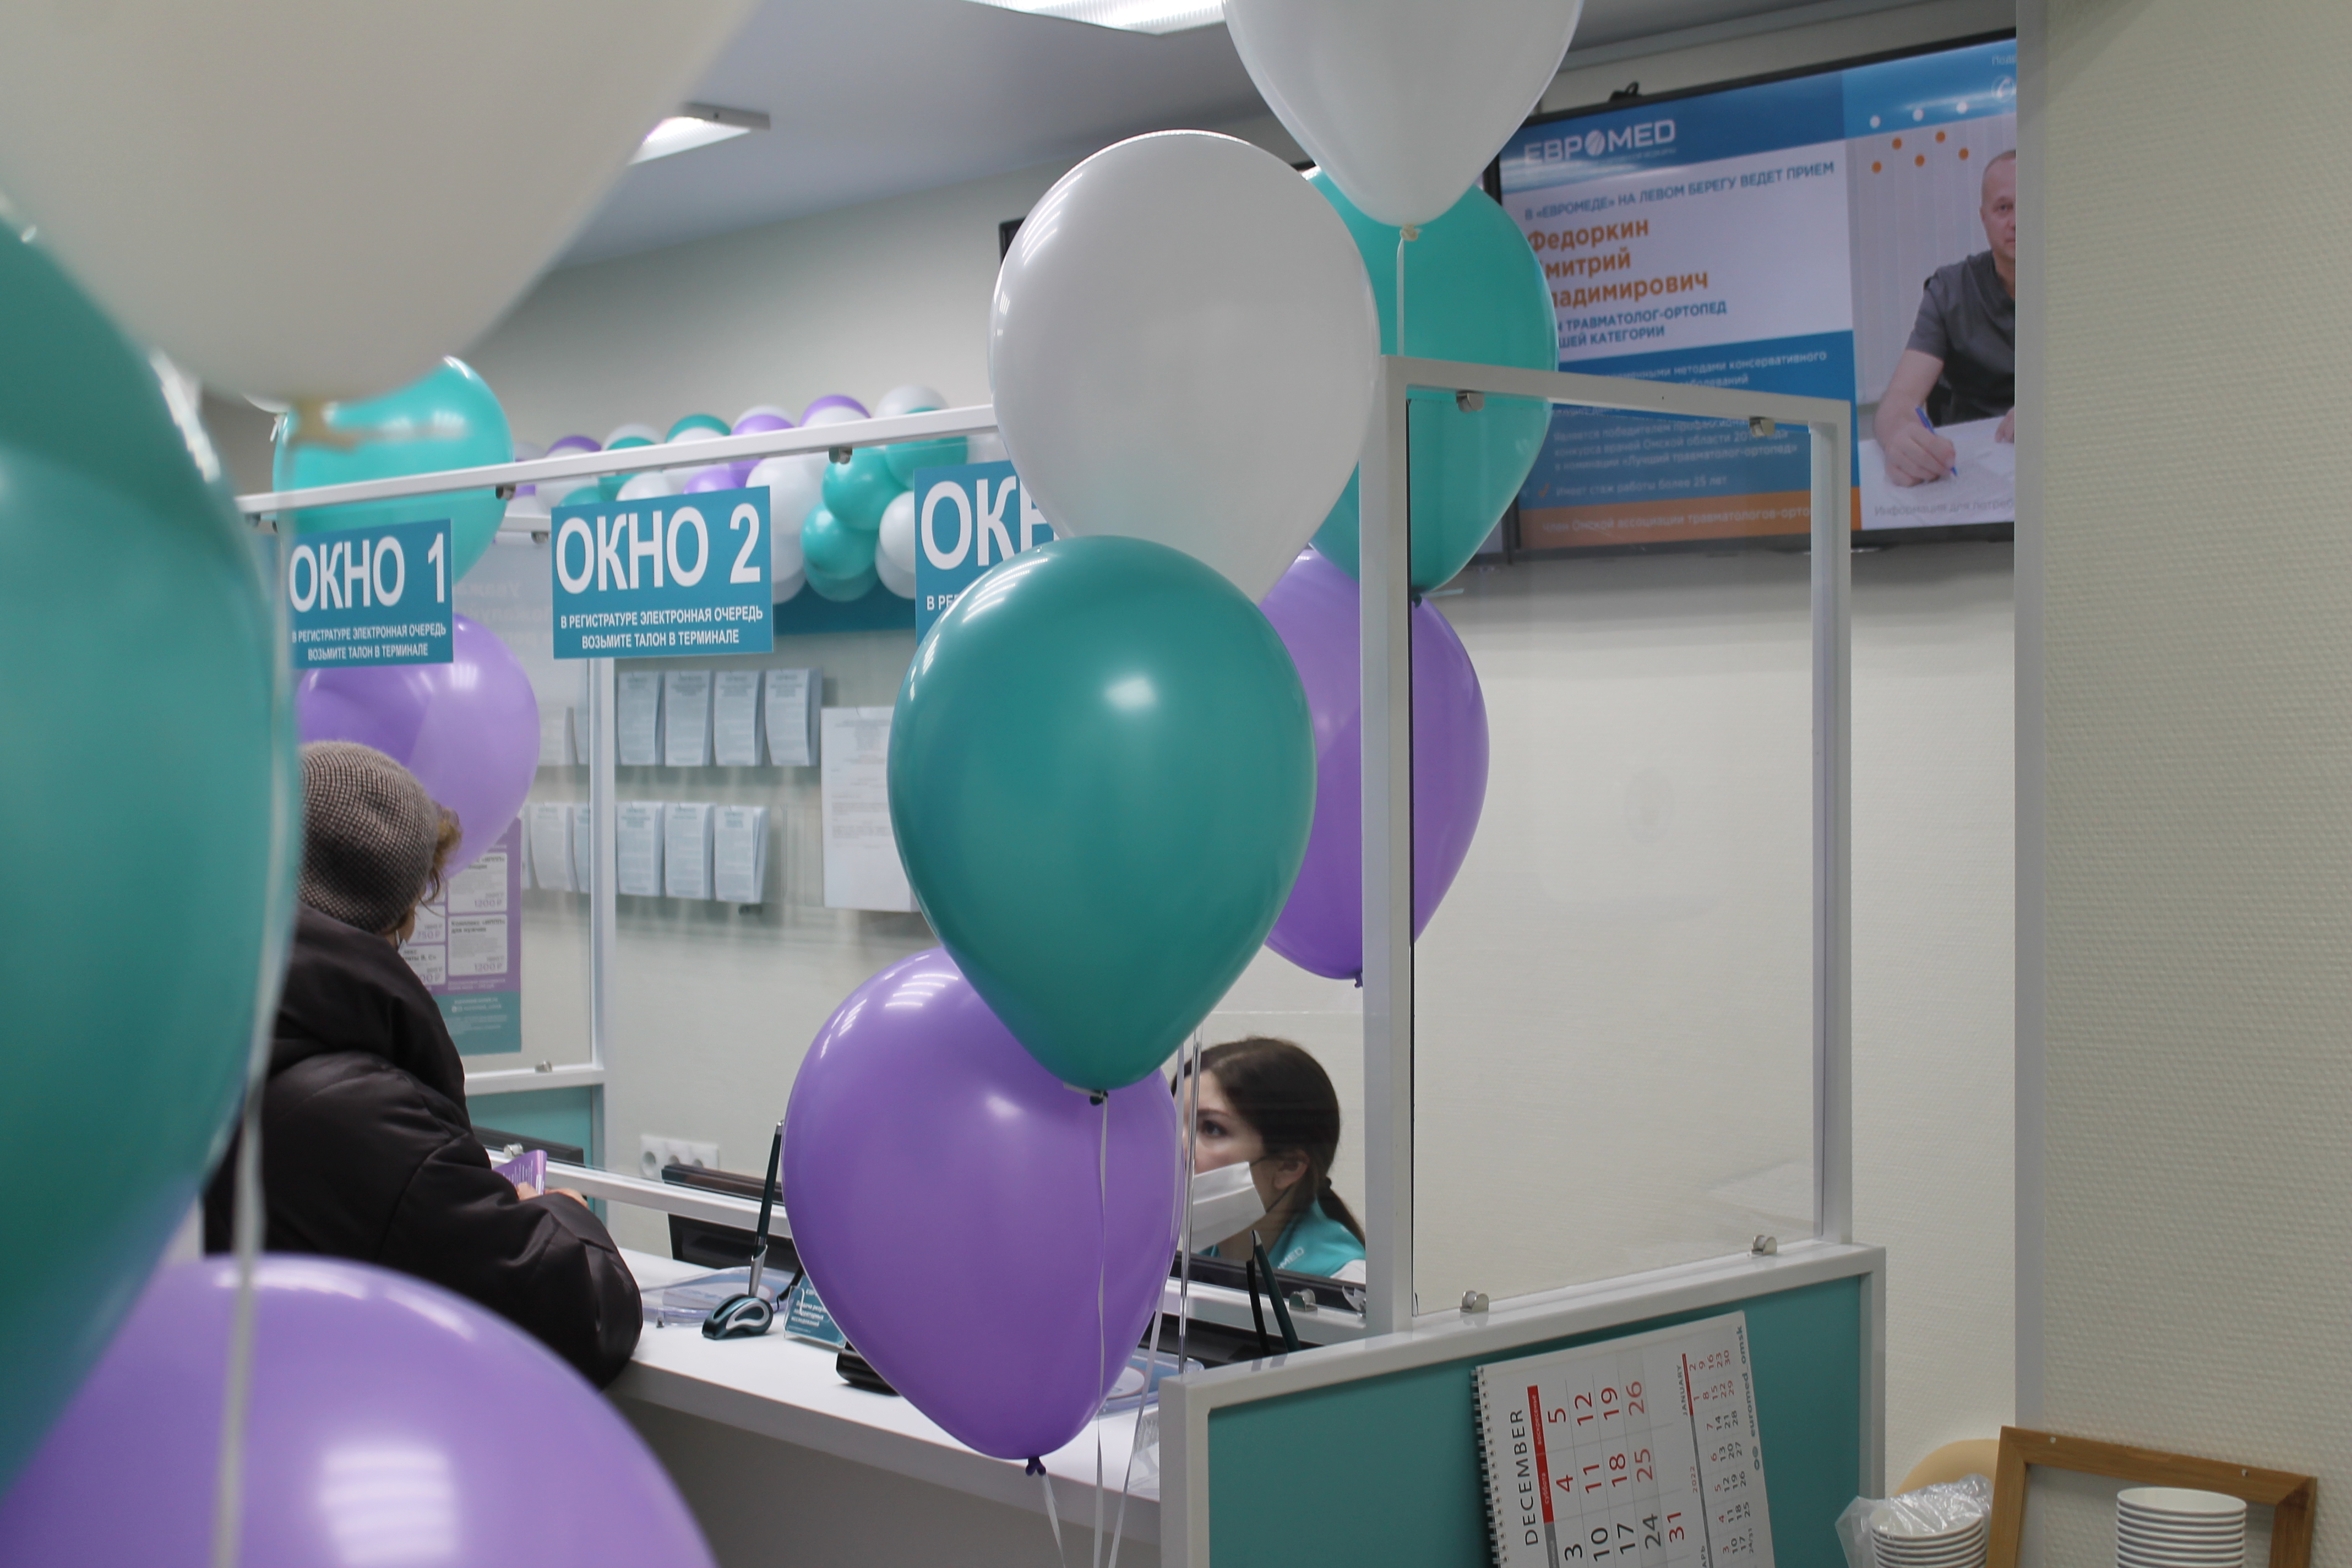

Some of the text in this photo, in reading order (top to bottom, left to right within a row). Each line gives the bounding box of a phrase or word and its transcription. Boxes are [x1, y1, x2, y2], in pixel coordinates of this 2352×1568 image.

[1525, 161, 1834, 220] В «ЕВРОМЕДЕ» НА ЛЕВОМ БЕРЕГУ ВЕДЕТ ПРИЕМ
[1528, 219, 1648, 252] Федоркин
[1541, 246, 1631, 280] митрий
[1567, 301, 1727, 330] ТРАВМАТОЛОГ-ОРТОПЕД
[1559, 325, 1665, 348] ШЕЙ КАТЕГОРИИ
[1674, 361, 1727, 375] методами
[1729, 351, 1827, 370] консервативного
[1688, 507, 1810, 525] травматологов-орто
[556, 503, 760, 594] ОКНО 2
[289, 532, 445, 613] ОКНО 1
[560, 615, 567, 629] В
[569, 612, 638, 629] РЕГИСТРАТУРЕ
[640, 608, 711, 625] ЭЛЕКТРОННАЯ
[714, 605, 763, 623] ОЧЕРЕДЬ
[927, 595, 935, 611] В
[292, 623, 447, 643] В РЕГИСТРАТУРЕ ЭЛЕКТРОННАЯ ОЧЕРЕДЬ
[581, 629, 739, 649] ВОЗЬМИТЕ ТАЛОН В ТЕРМИНАЛЕ
[308, 643, 428, 661] ВОЗЬМИТЕ ТАЛОН В ТЕРМИНАЛЕ
[1689, 1363, 1696, 1371] 2
[1723, 1349, 1731, 1365] 30
[1676, 1364, 1688, 1416] JANUARY
[1727, 1380, 1734, 1396] 29
[1731, 1410, 1739, 1426] 28
[1698, 1360, 1729, 1554] 3 4 5 6 7 8 9
[1707, 1354, 1738, 1554] 10 11 12 13 14 15 16
[1716, 1352, 1746, 1551] 17 18 19 20 21 22 23
[1735, 1441, 1743, 1457] 27
[1510, 1409, 1539, 1545] DECEMBER
[1575, 1392, 1610, 1562] 10 11 12
[1600, 1387, 1636, 1555] 17 18 19
[1626, 1381, 1662, 1549] 24 25 26
[1739, 1471, 1746, 1487] 26
[1547, 1408, 1583, 1561] 3 4 5
[1690, 1466, 1698, 1494] 2022
[1743, 1501, 1750, 1518] 25
[1667, 1512, 1685, 1543] 31
